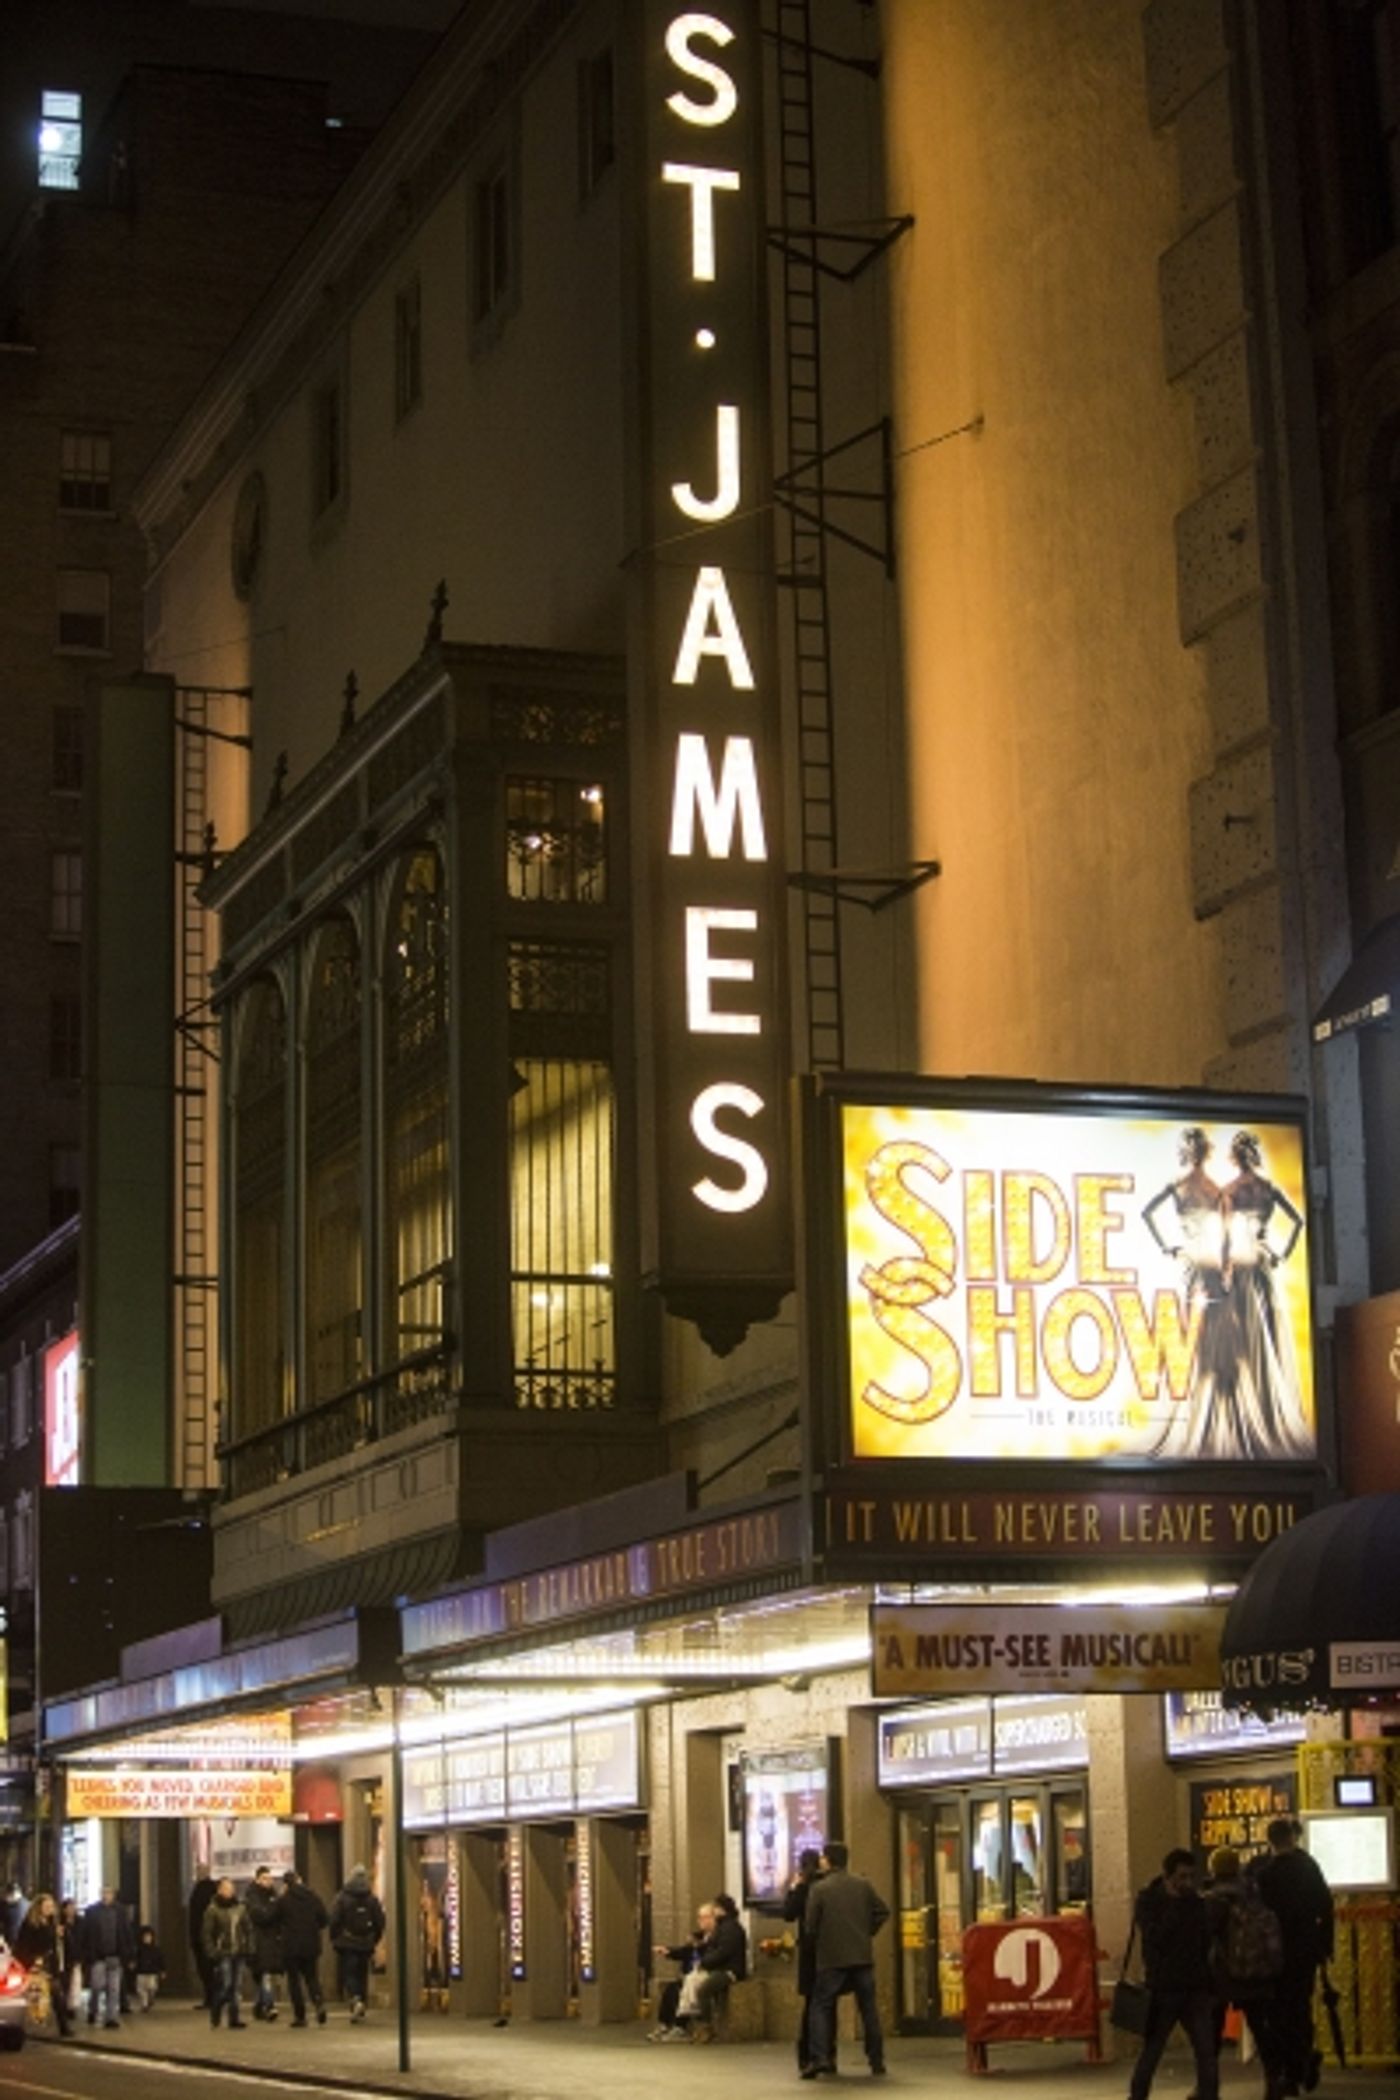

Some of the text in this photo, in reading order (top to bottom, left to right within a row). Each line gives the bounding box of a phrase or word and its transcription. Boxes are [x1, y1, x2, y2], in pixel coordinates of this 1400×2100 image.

[670, 404, 769, 1214] JAMES
[860, 1139, 1139, 1303] SIDE
[858, 1262, 1206, 1425] SHOW
[1066, 1409, 1134, 1429] MUSICAL
[657, 1533, 706, 1587] TRUE
[717, 1511, 781, 1572] STORY
[846, 1501, 1295, 1542] IT WILL NEVER LEAVE YOU
[914, 1634, 1051, 1669] MUST-SEE
